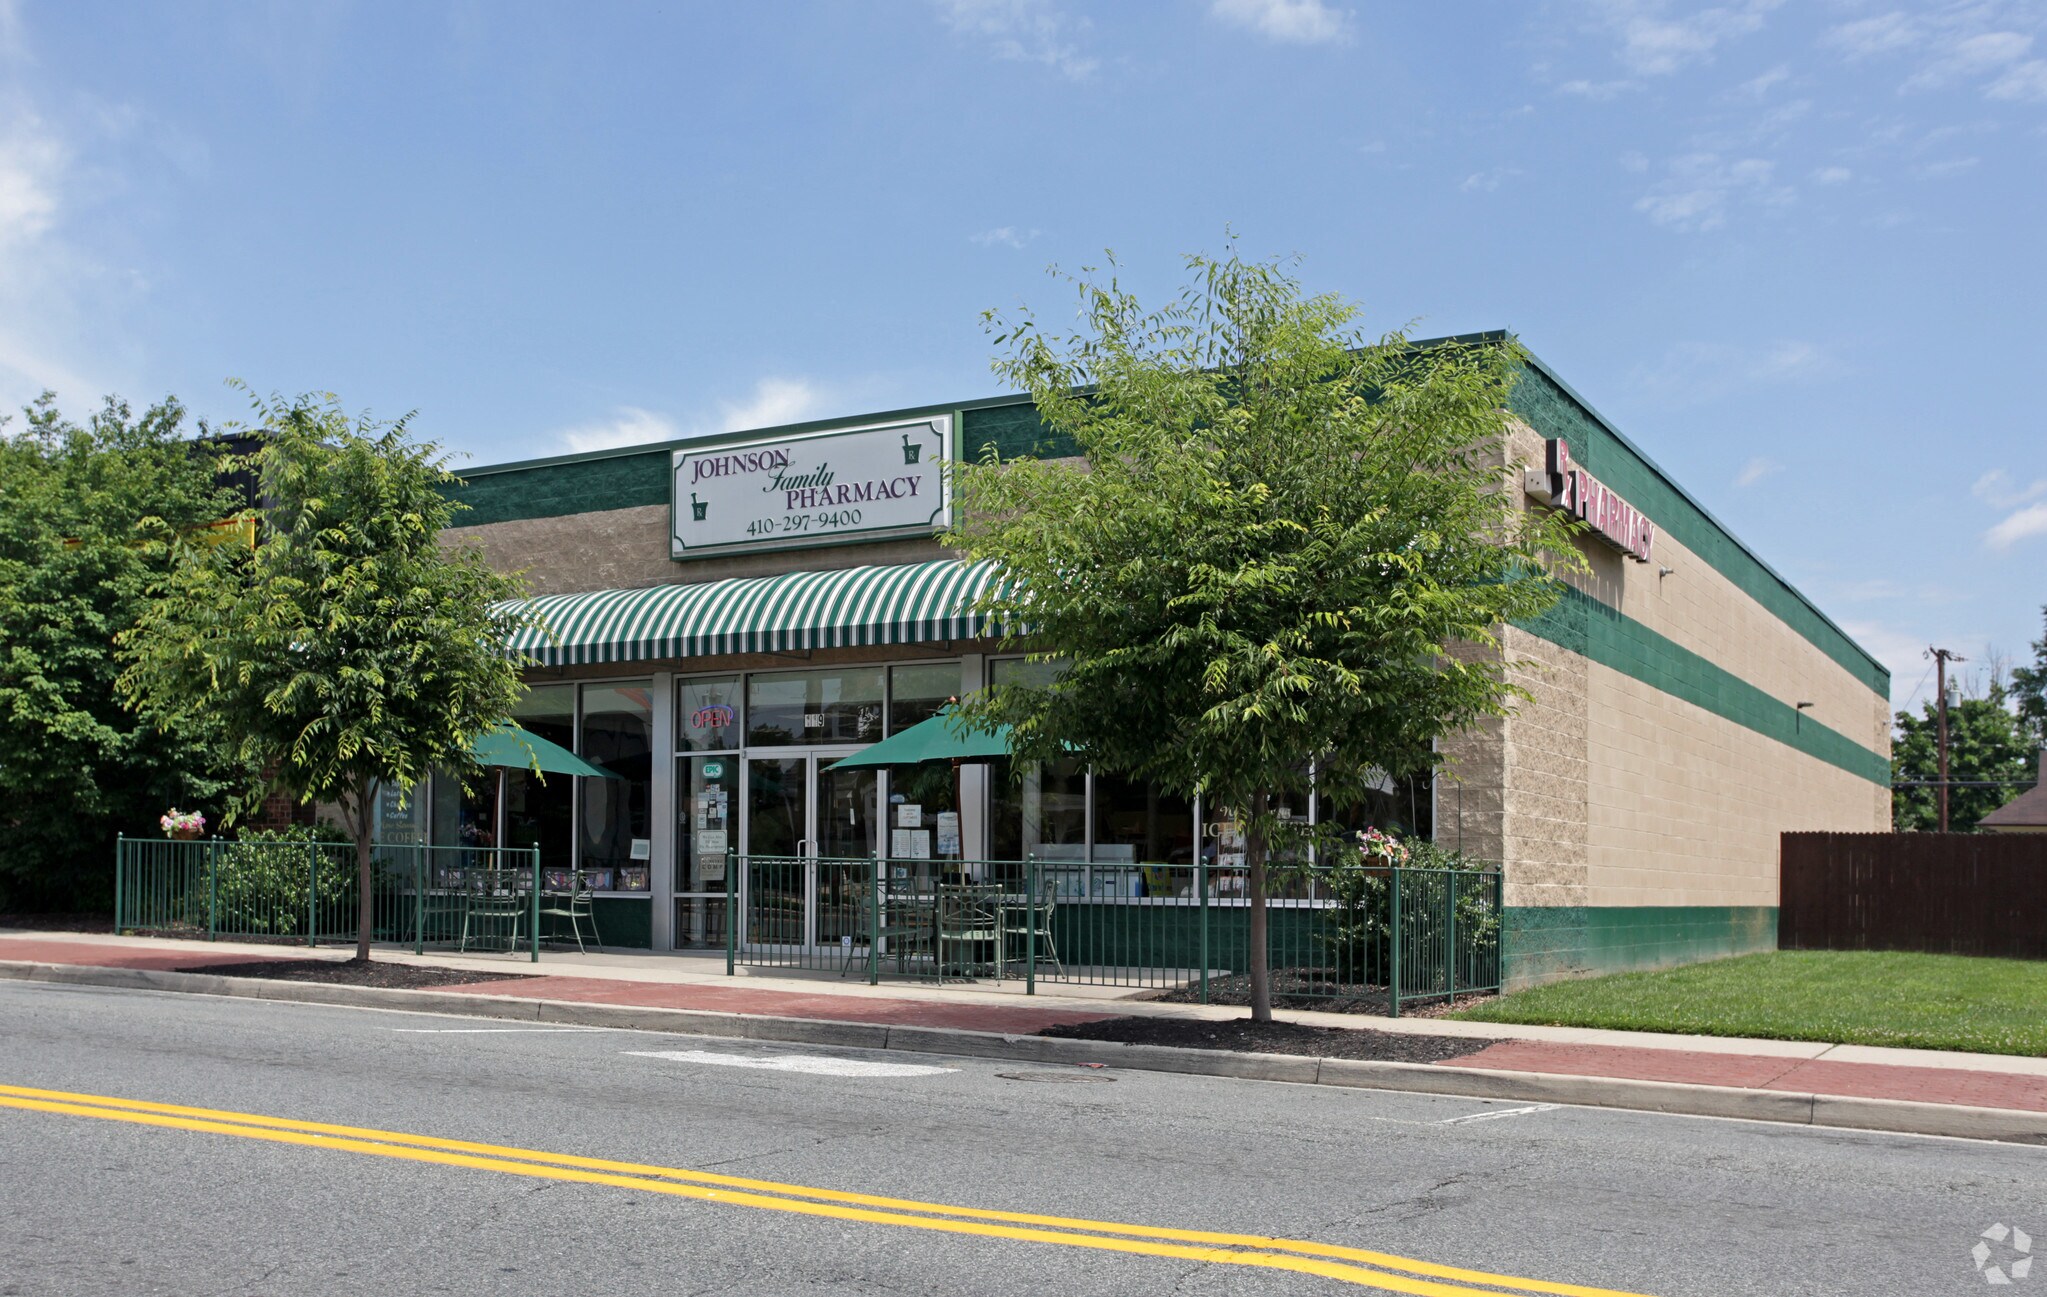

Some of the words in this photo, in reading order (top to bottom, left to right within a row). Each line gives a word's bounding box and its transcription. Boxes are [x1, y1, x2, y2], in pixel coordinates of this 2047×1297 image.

[691, 448, 790, 485] JOHNSON
[762, 460, 835, 494] Family
[786, 475, 922, 510] PHARMACY
[746, 508, 862, 536] 410-297-9400
[1576, 470, 1655, 563] PHARMACY
[690, 706, 730, 729] OPEN
[705, 765, 719, 774] EPIC
